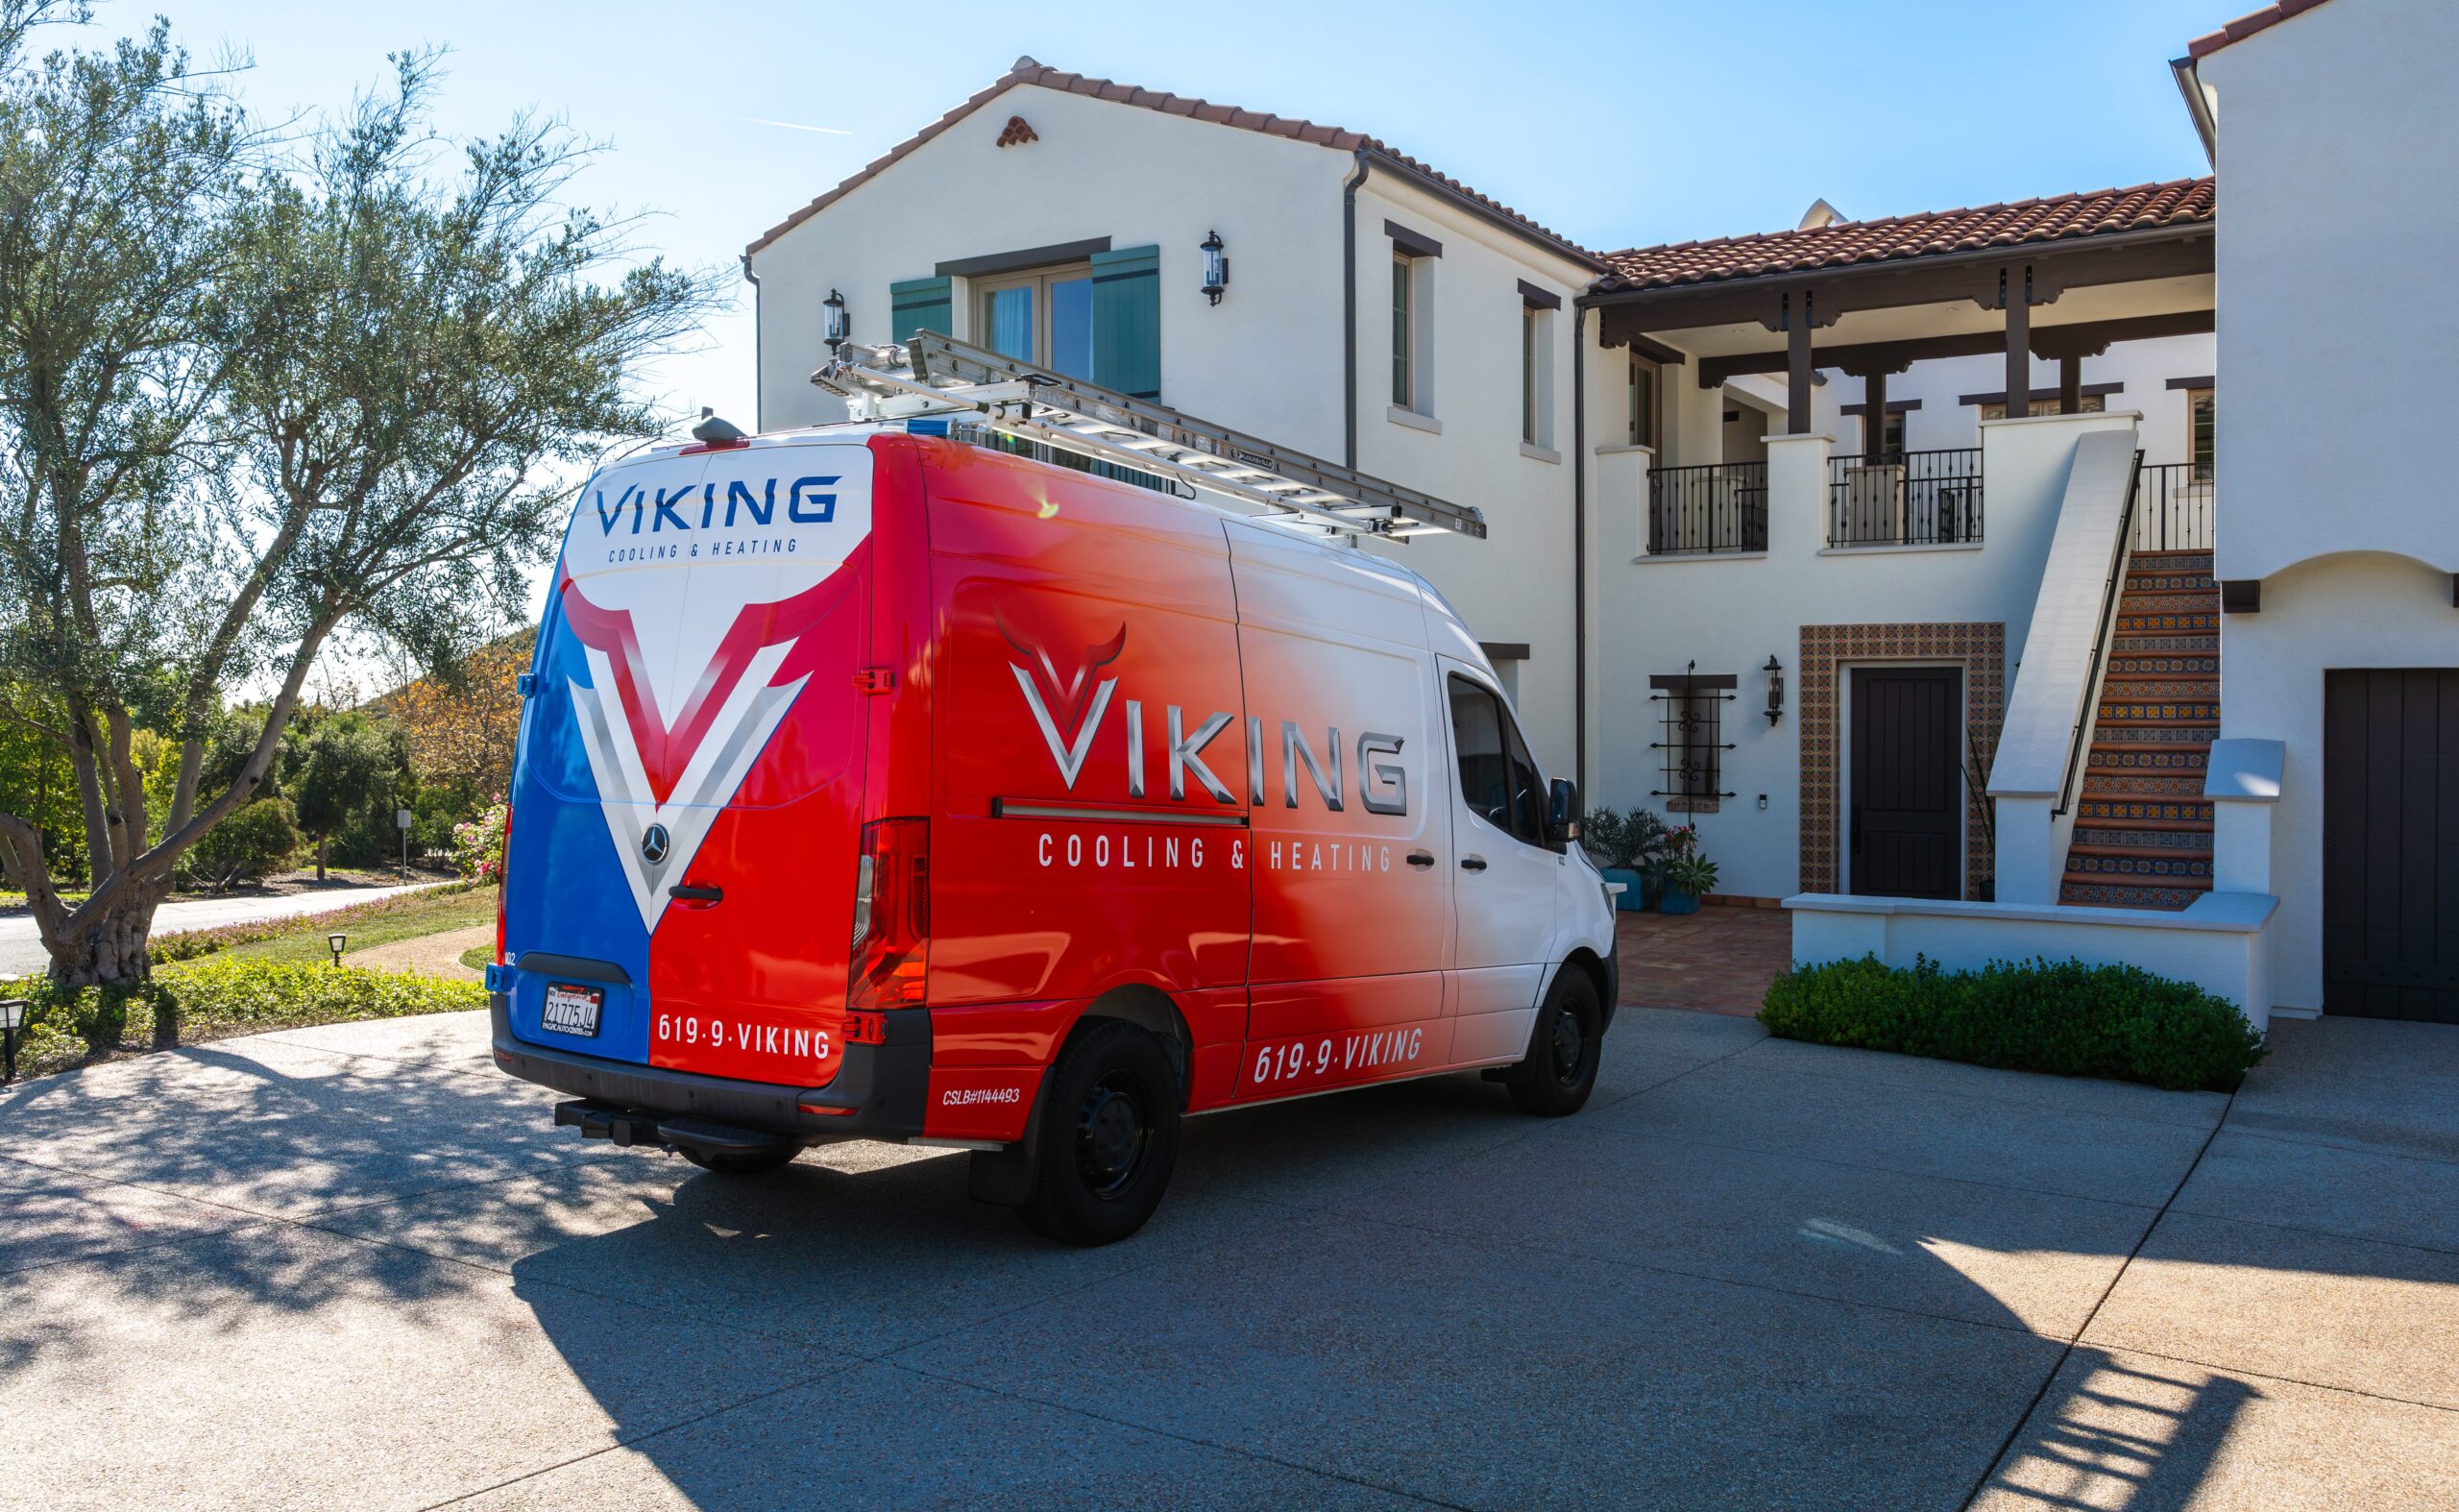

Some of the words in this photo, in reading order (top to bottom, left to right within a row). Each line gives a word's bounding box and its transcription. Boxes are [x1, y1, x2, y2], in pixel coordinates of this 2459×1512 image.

[596, 476, 842, 537] VIKING
[609, 544, 677, 563] COOLING
[691, 544, 698, 557] &
[713, 539, 797, 555] HEATING
[1009, 660, 1406, 817] VIKING
[1038, 834, 1204, 867] COOLING
[1231, 840, 1244, 869] &
[1271, 841, 1390, 872] HEATING
[942, 1087, 1020, 1106] CSLB#1144493
